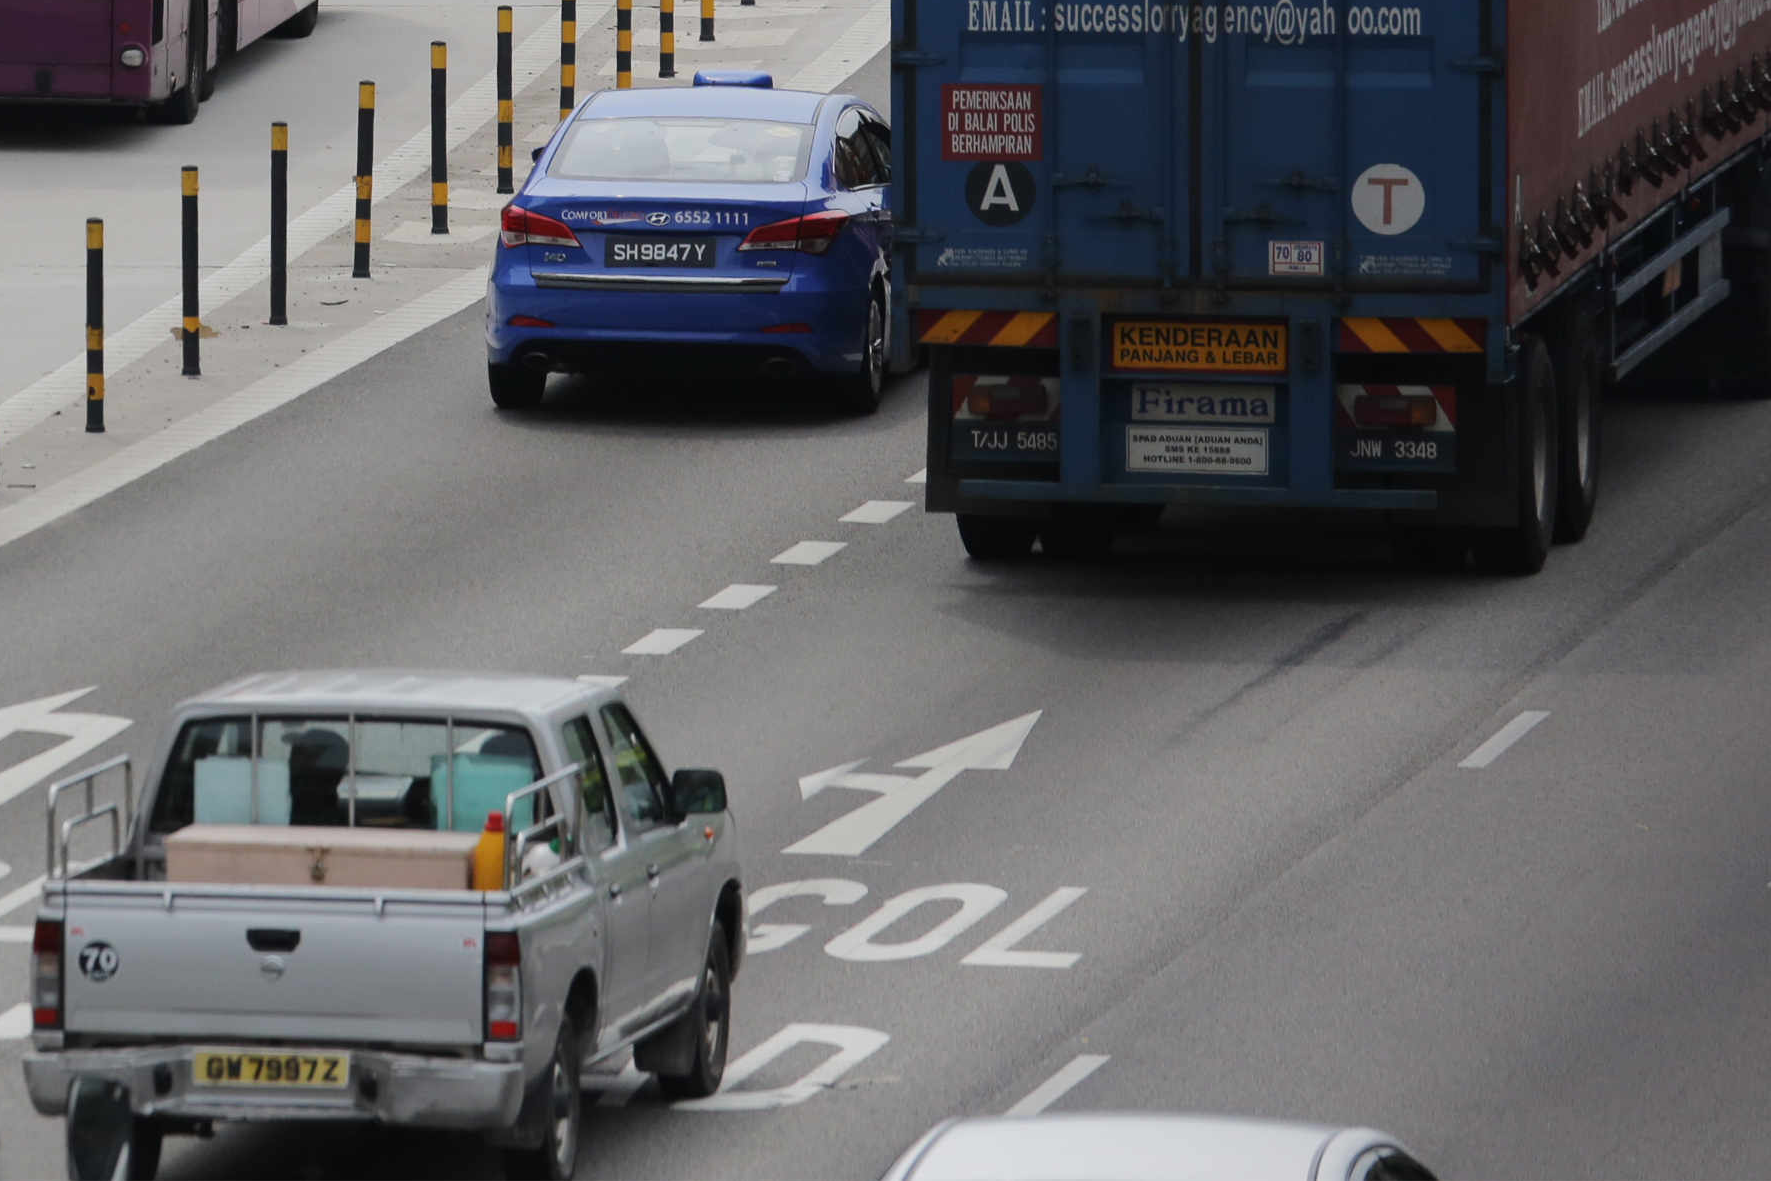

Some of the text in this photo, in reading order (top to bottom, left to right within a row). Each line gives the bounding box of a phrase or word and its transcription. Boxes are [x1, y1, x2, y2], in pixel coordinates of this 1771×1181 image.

[952, 89, 1032, 111] PEMERIKSAAN
[948, 112, 1036, 133] DI BALAI POLIS
[951, 134, 1032, 155] BERHAMPIRAN
[980, 163, 1020, 212] A
[1366, 177, 1410, 225] T
[674, 211, 710, 225] 6552
[715, 211, 749, 226] 1111
[613, 243, 706, 261] SH9847Y
[1275, 246, 1290, 259] 70
[1297, 250, 1312, 263] 80
[1120, 326, 1279, 349] KENDERAAN
[1120, 349, 1278, 366] PANJANG & LEBAR
[1136, 387, 1269, 417] Firama
[1017, 431, 1058, 450] 5485
[1132, 434, 1157, 443] SPAD
[1158, 435, 1192, 444] ADUAN
[1349, 438, 1437, 459] JNW 3348
[1143, 454, 1185, 464] HOTLINE
[1164, 445, 1185, 453] SMS
[1187, 446, 1200, 454] KE
[82, 946, 118, 972] 70
